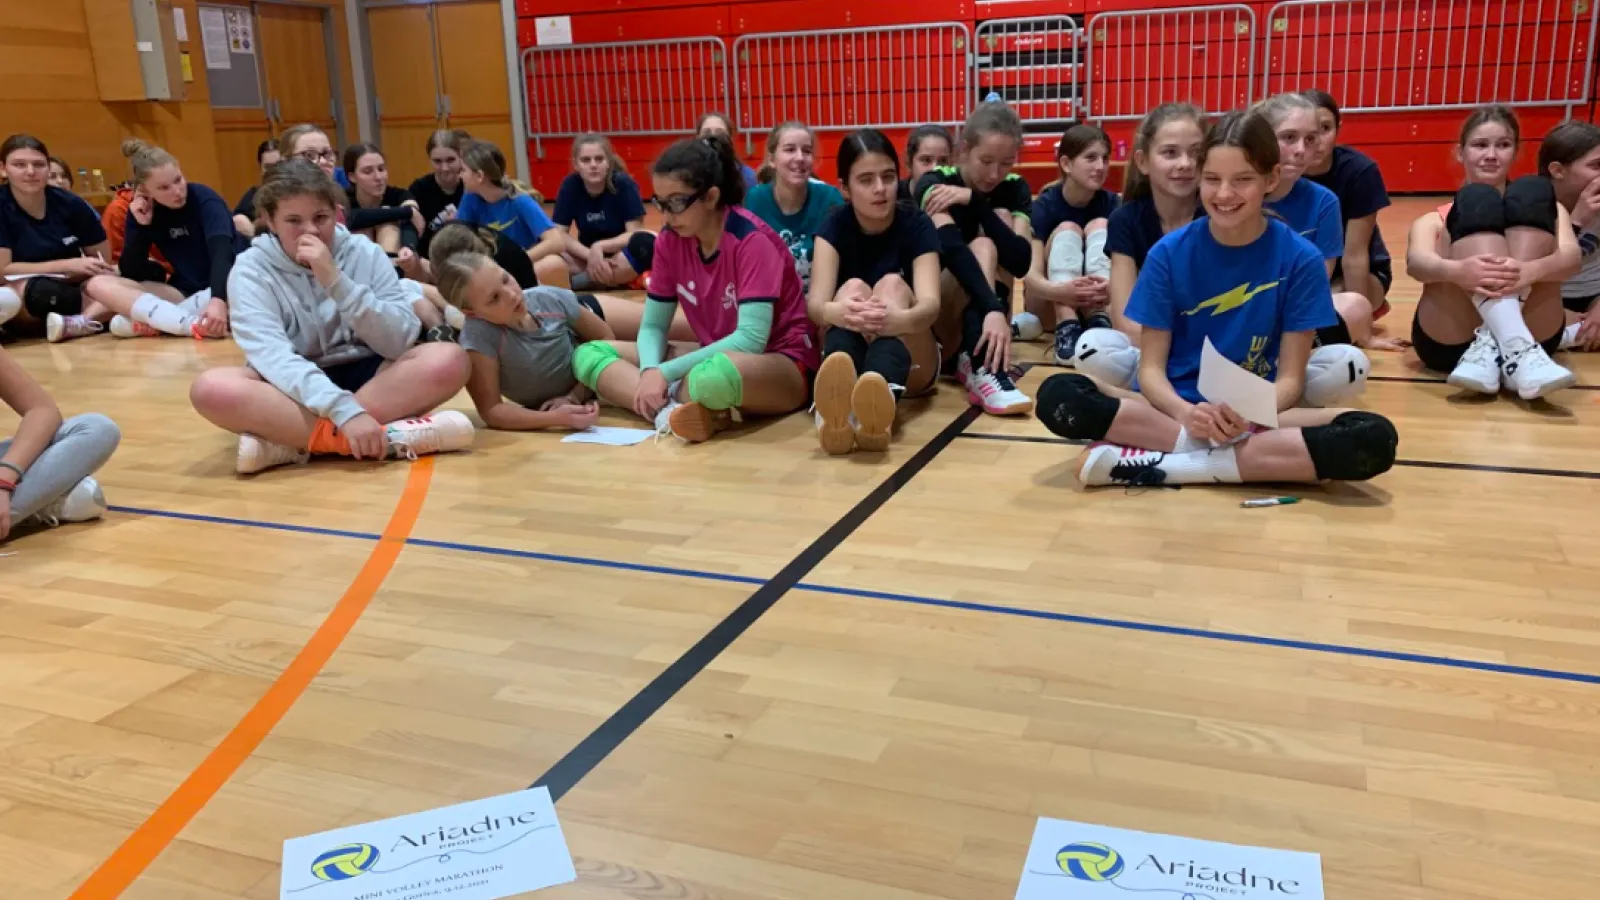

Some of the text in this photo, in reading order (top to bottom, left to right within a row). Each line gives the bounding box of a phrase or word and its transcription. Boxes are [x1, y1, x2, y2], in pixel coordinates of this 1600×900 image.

[390, 811, 536, 852] Ariadne
[438, 834, 493, 849] PROJECT
[386, 880, 431, 895] VOLLEY
[434, 864, 504, 883] MARATHON
[1136, 853, 1301, 894] Ariadne
[1184, 881, 1247, 895] PROJECT
